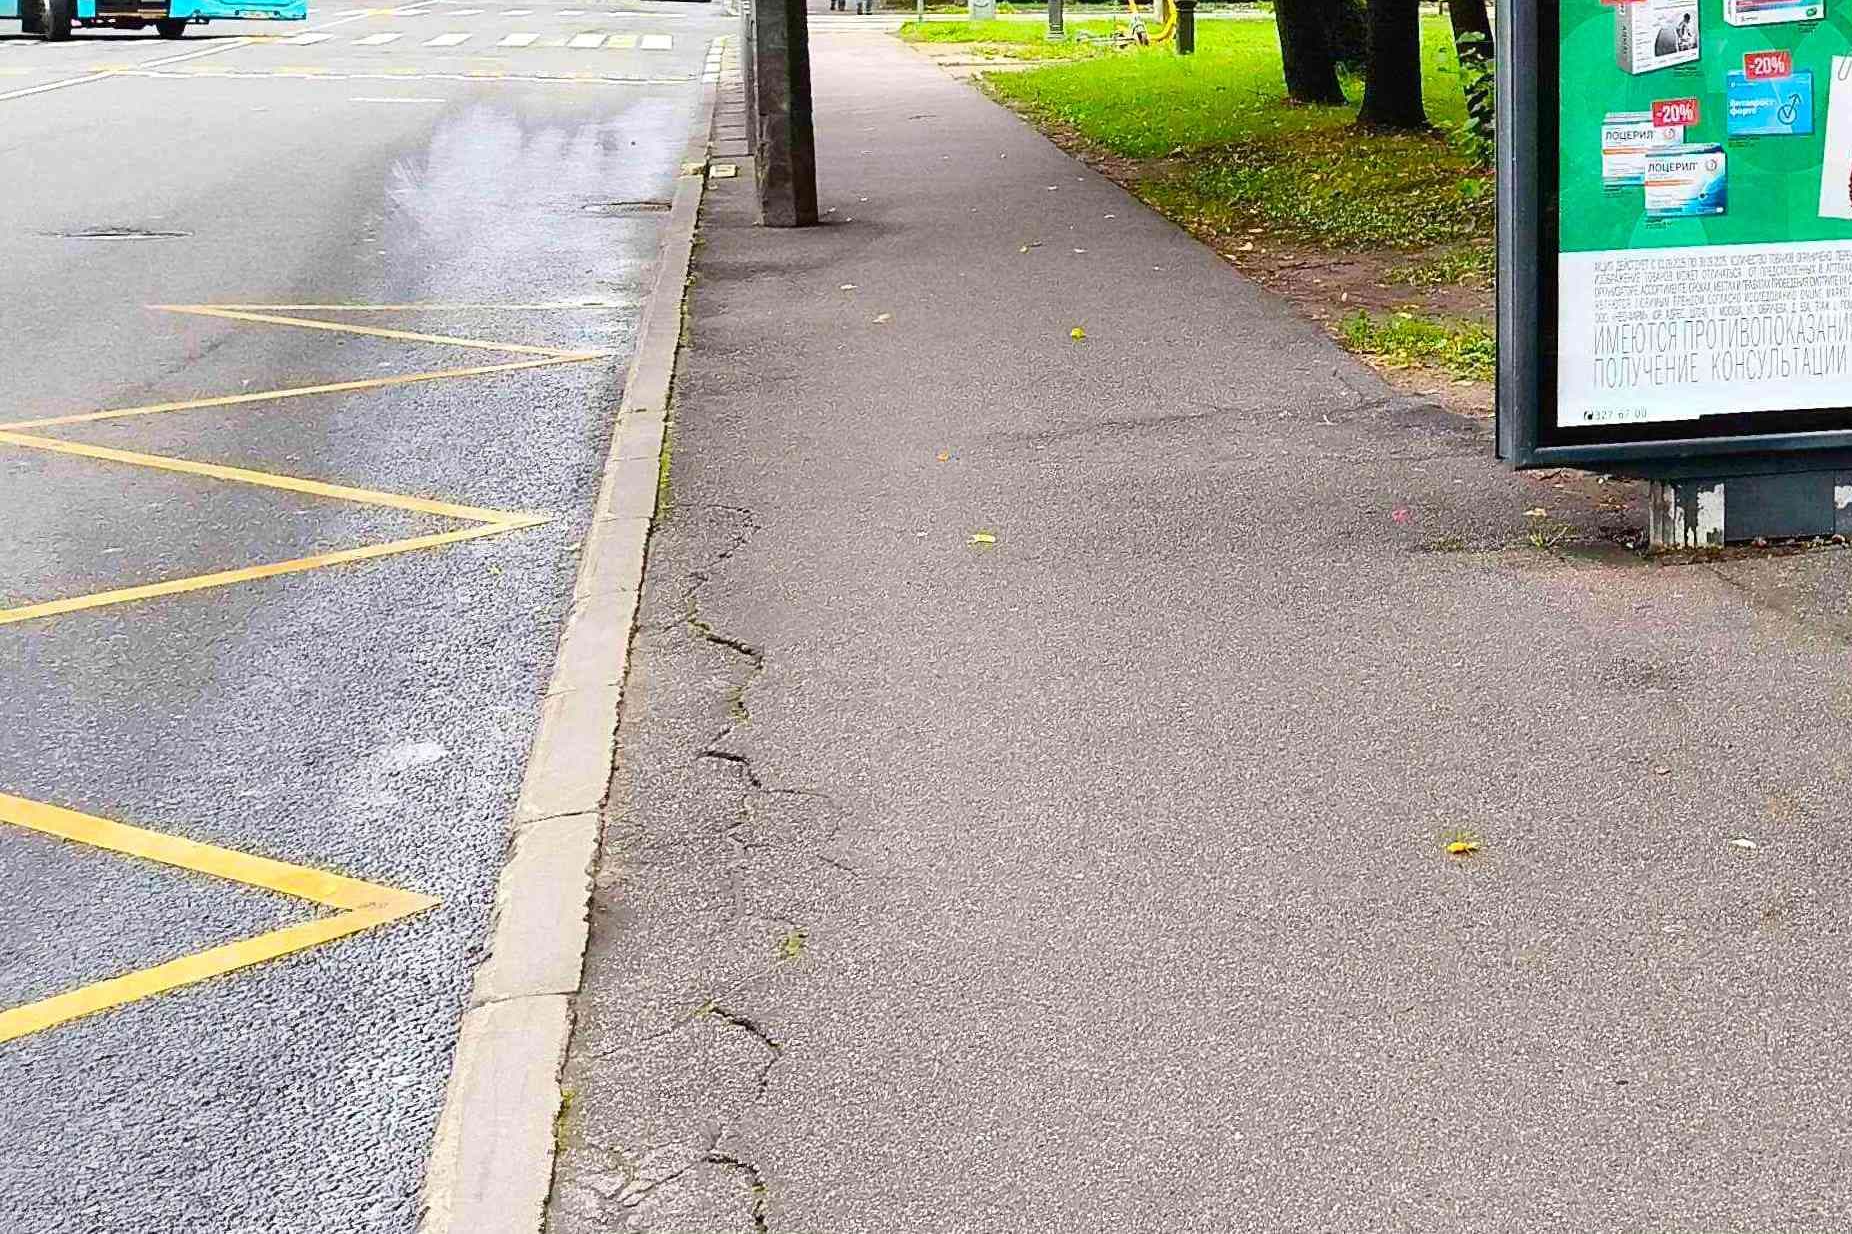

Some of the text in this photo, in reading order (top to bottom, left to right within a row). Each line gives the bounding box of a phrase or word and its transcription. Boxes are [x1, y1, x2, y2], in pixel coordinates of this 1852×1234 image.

[1749, 56, 1785, 75] -20%
[1655, 104, 1694, 123] -20%
[1605, 130, 1654, 142] ЛОЦЕРИЛ
[1648, 162, 1696, 174] ЛОЦЕРИЛ
[1594, 320, 1678, 356] ИМЕЮТСЯ
[1594, 352, 1699, 389] ПОЛУЧЕНИЕ
[1711, 344, 1847, 382] КОНСУЛЬТАЦИИ
